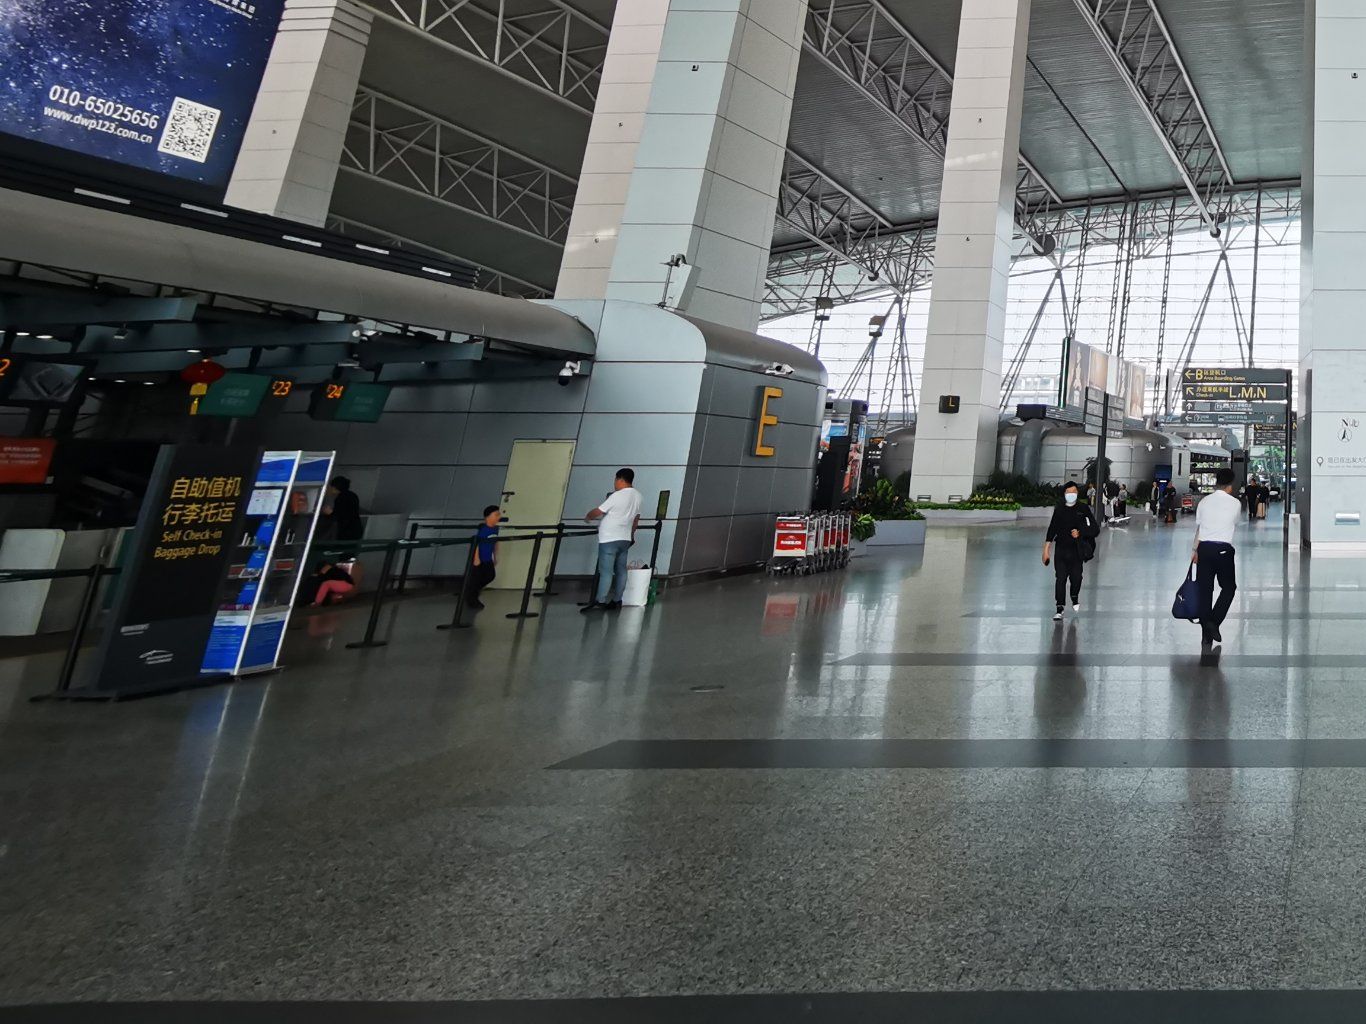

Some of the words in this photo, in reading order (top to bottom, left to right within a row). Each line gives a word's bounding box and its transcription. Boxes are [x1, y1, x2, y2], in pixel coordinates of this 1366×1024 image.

[43, 106, 153, 144] www.dwp123.com.cn
[49, 85, 160, 129] 010-65025656
[755, 386, 783, 456] E
[170, 477, 242, 499] 自助值机
[162, 502, 236, 526] 行李托运
